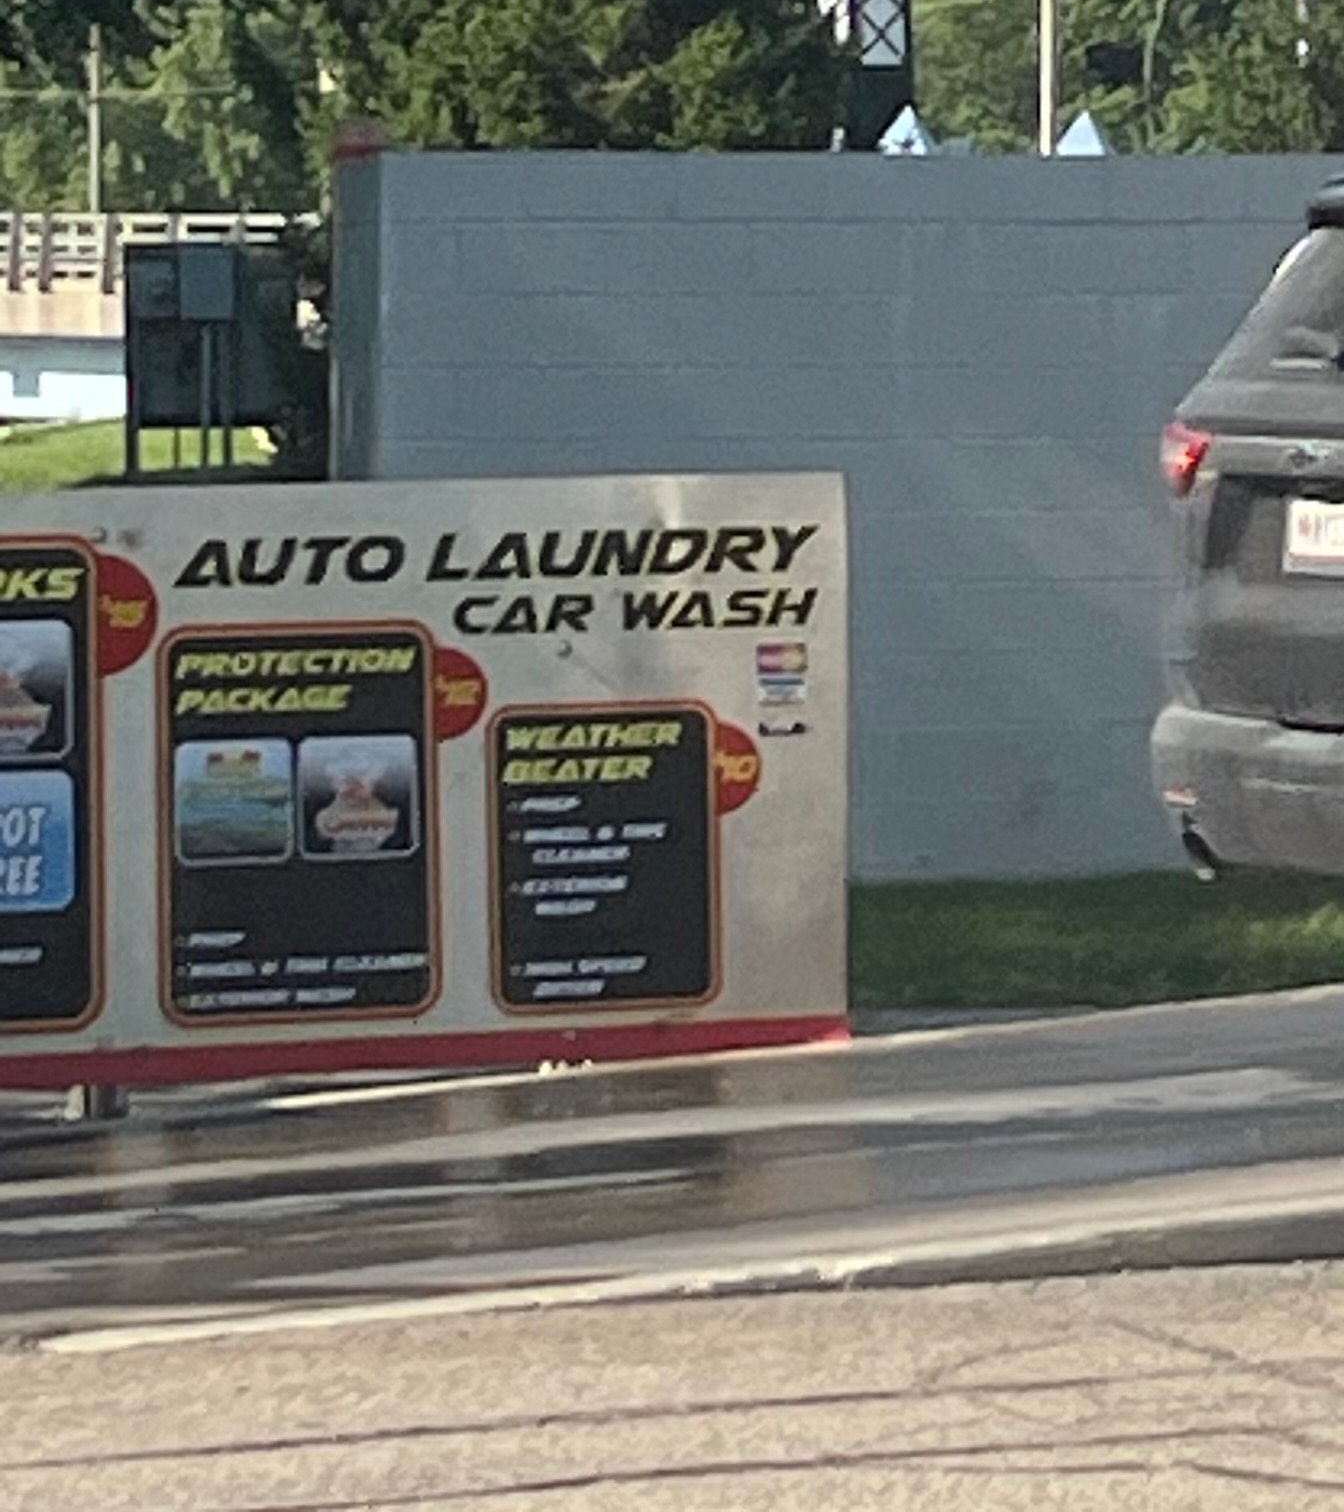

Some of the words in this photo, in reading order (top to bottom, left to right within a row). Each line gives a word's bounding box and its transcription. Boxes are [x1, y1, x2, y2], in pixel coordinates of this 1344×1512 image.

[172, 535, 405, 587] AUTO
[427, 524, 819, 582] LAUNDRY
[453, 593, 595, 634] CAR
[622, 587, 818, 631] WASH
[174, 645, 418, 680] PROTECTION
[174, 683, 353, 716] PACKAGE
[506, 722, 683, 751] WEATHER
[503, 754, 653, 784] BEATER
[0, 805, 47, 848] OT
